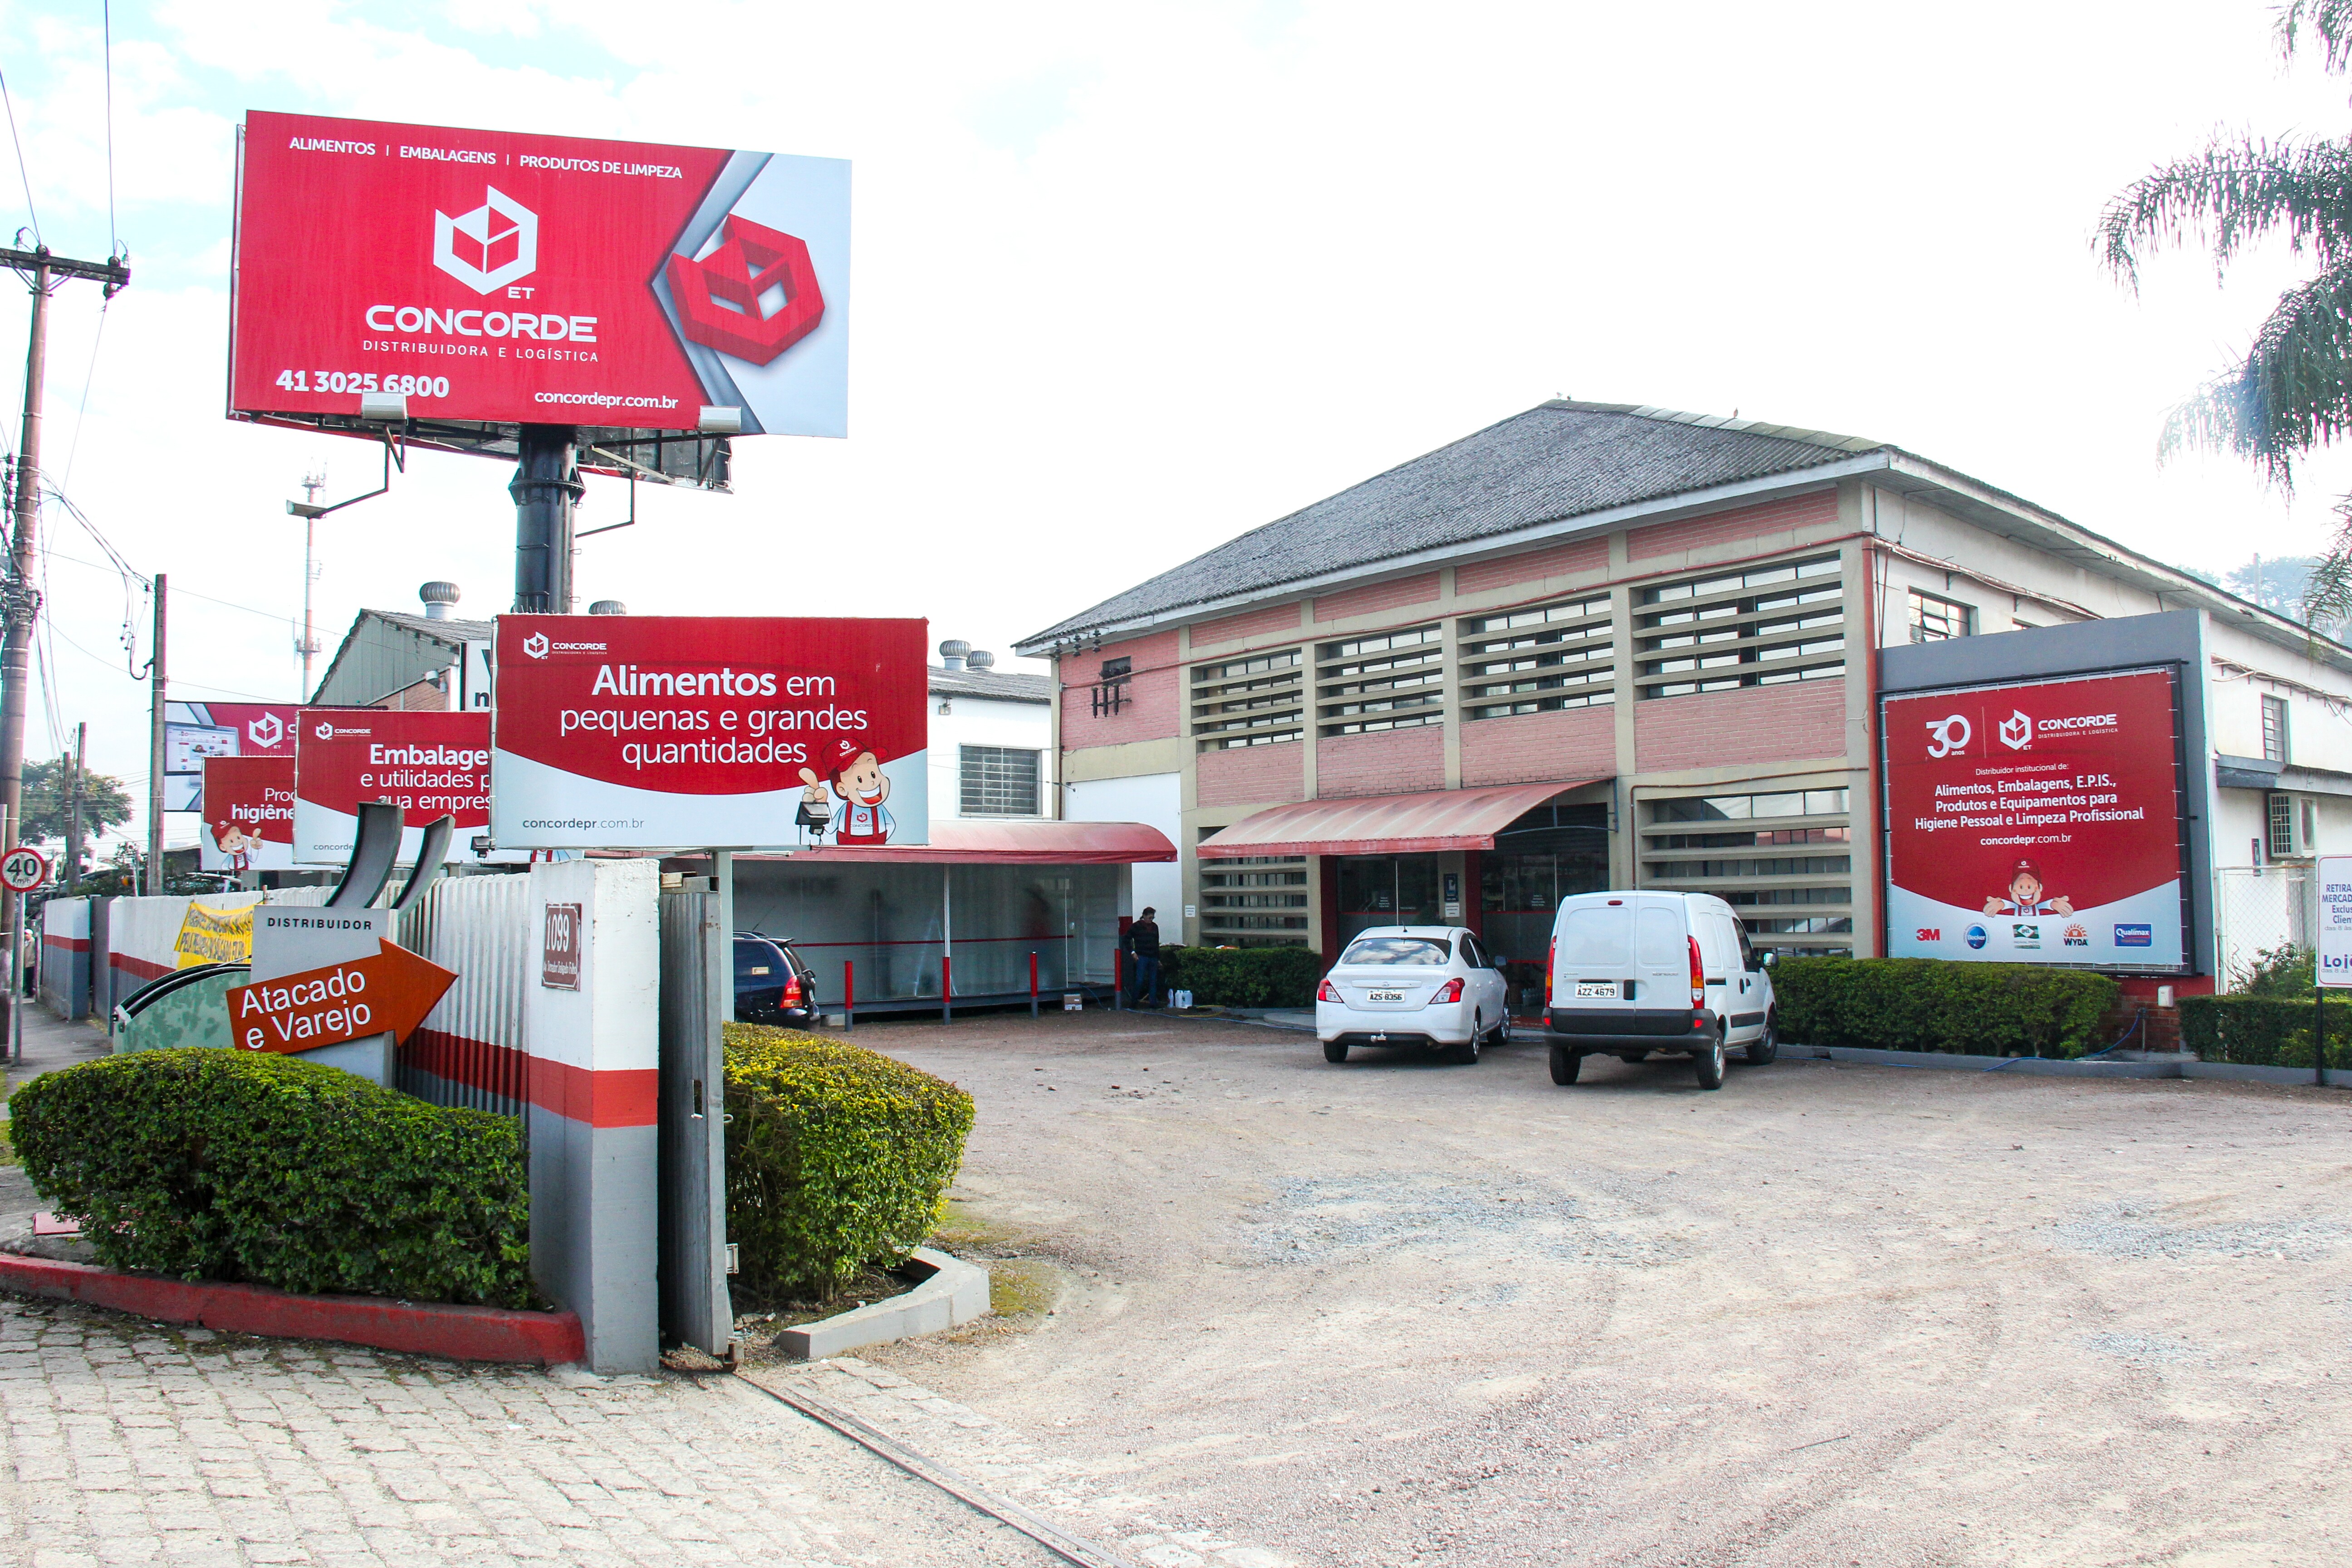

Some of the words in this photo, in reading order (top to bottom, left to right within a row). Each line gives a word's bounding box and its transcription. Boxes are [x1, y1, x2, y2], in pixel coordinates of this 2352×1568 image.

[289, 137, 376, 156] ALIMENTOS
[400, 145, 497, 165] EMBALAGENS
[519, 155, 600, 172] PRODUTOS
[602, 161, 621, 174] DE
[623, 163, 683, 179] LIMPEZA
[508, 286, 535, 299] ET
[365, 305, 598, 343] CONCORDE
[363, 340, 489, 357] DISTRIBUIDORA
[498, 347, 507, 358] E
[516, 347, 598, 363] LOGÍSTICA
[275, 369, 310, 392] 41
[313, 371, 379, 394] 3025
[383, 374, 450, 398] 6800
[534, 390, 679, 410] concordepr.com.br
[552, 642, 607, 650] CONCORDE
[591, 664, 777, 697] Alimentos
[786, 676, 835, 697] em
[560, 709, 710, 737] pequenas
[719, 710, 738, 731] e
[748, 703, 867, 738] grandes
[2038, 713, 2117, 731] CONCORDE
[1926, 714, 1971, 758] 30
[2038, 731, 2080, 739] DISTRIBUIDORA
[370, 744, 489, 771] Embalage
[622, 736, 808, 770] quantidades
[360, 774, 373, 788] e
[380, 769, 474, 788] utilidades
[1975, 767, 2014, 775] Distribuidor
[2015, 764, 2056, 773] institucional
[1935, 783, 1995, 797] Alimentos,
[1997, 779, 2073, 793] Embalagens,
[1936, 800, 1987, 813] Produtos
[1989, 800, 1997, 810] e
[1999, 794, 2087, 811] Equipamentos
[2089, 794, 2117, 808] para
[523, 818, 644, 831] concordepr.com.br
[1915, 817, 1958, 832] Higiene
[1960, 813, 2004, 828] Pessoal
[2005, 816, 2013, 826] e
[2015, 813, 2066, 827] Limpeza
[2069, 806, 2145, 823] Profissional
[1980, 833, 2072, 846] concordepr.com.br
[7, 858, 38, 876] 40
[2326, 883, 2352, 892] RETIRA
[2322, 894, 2352, 902] MERCAD
[267, 917, 372, 930] DISTRIBUIDOR
[2332, 915, 2352, 924] Clien
[546, 913, 570, 953] 1099
[1916, 928, 1940, 941] 3M
[2063, 938, 2088, 946] WYDA
[241, 968, 366, 1018] Atacado
[246, 1026, 265, 1049] e
[271, 999, 371, 1042] Varejo
